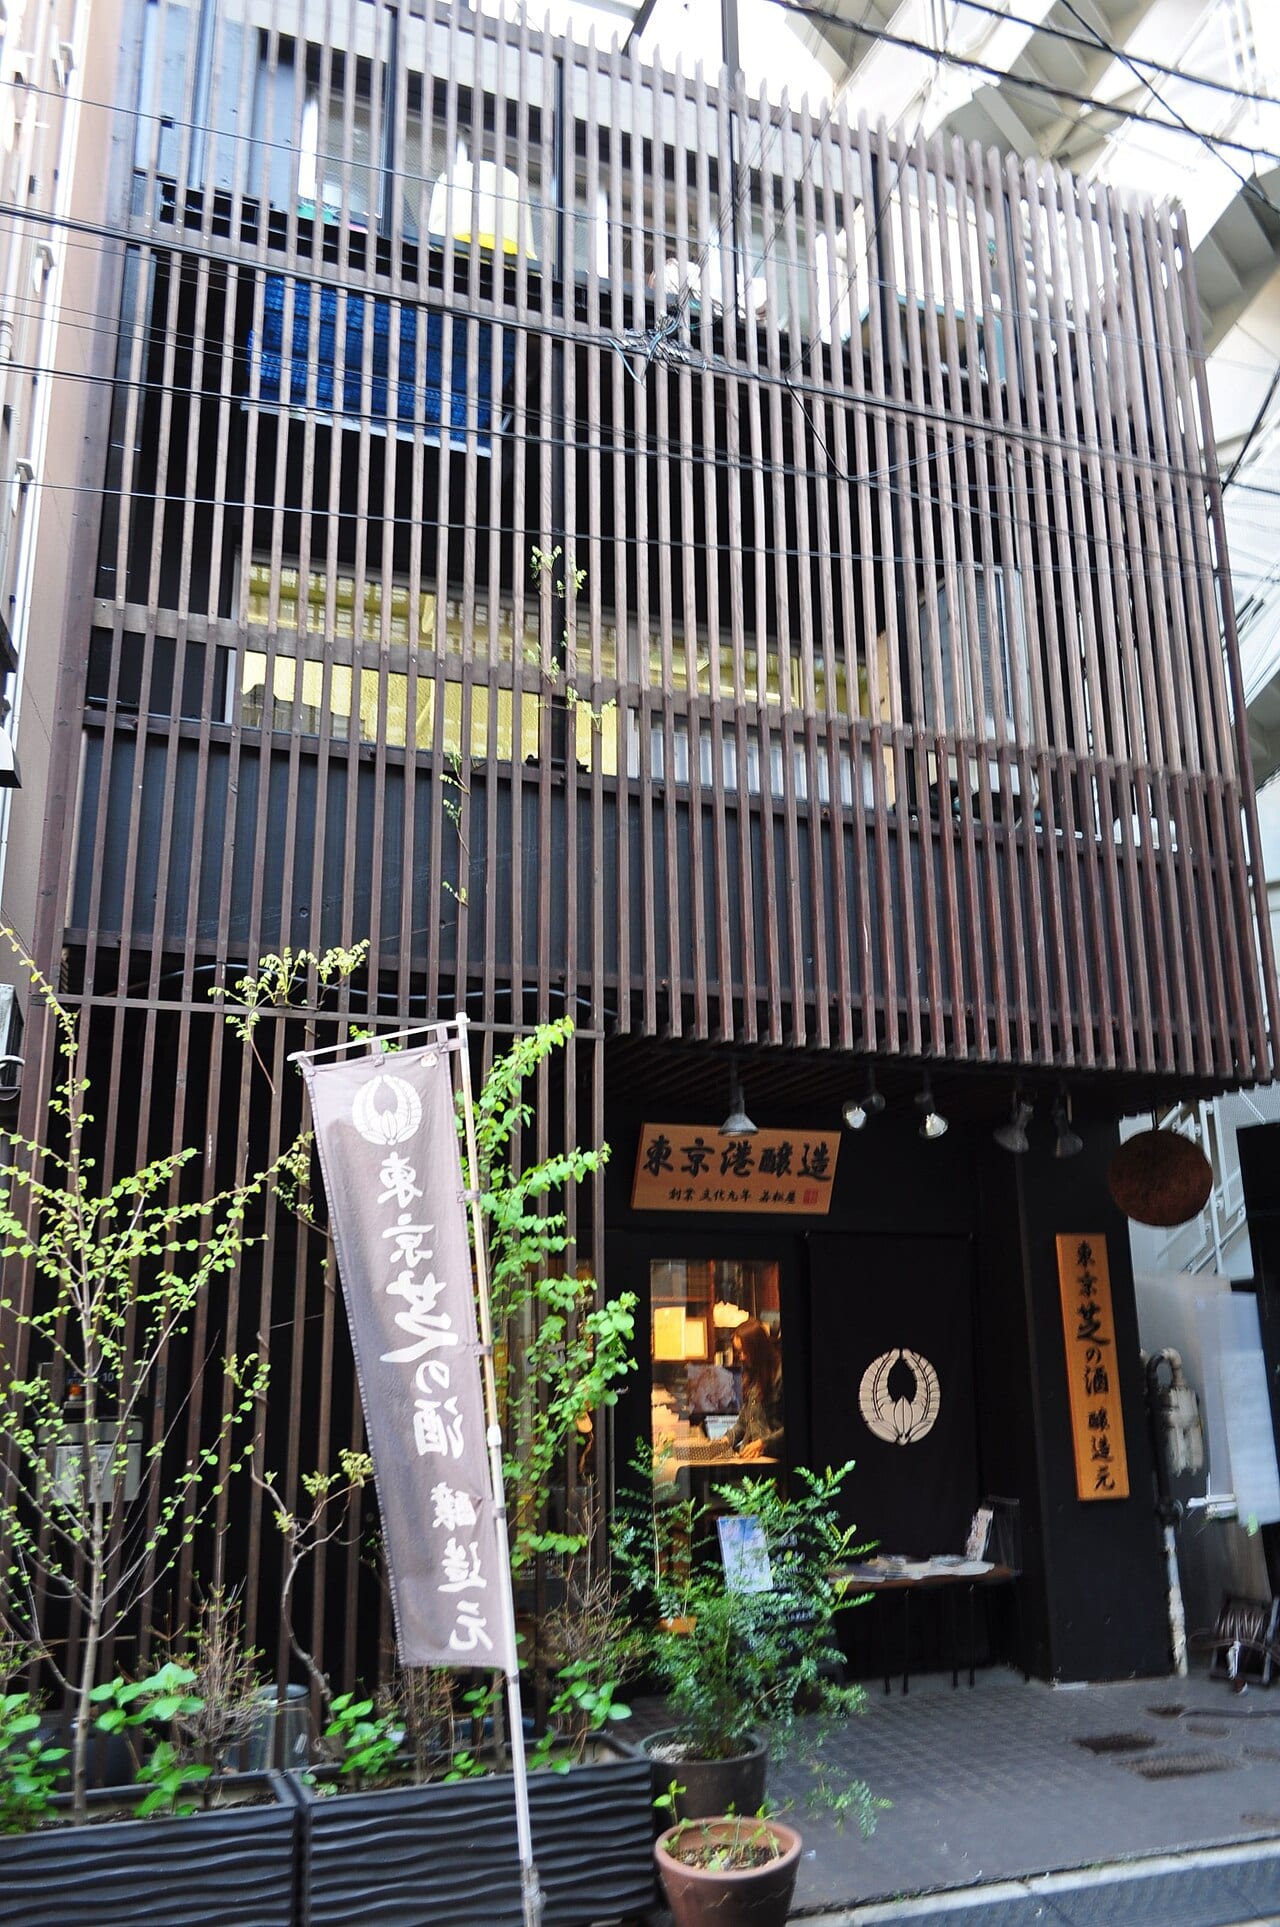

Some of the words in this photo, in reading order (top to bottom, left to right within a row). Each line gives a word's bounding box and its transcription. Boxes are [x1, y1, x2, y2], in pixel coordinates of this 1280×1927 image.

[643, 1135, 832, 1182] 東京港醸造
[1077, 1240, 1110, 1395] 東京芝の酒
